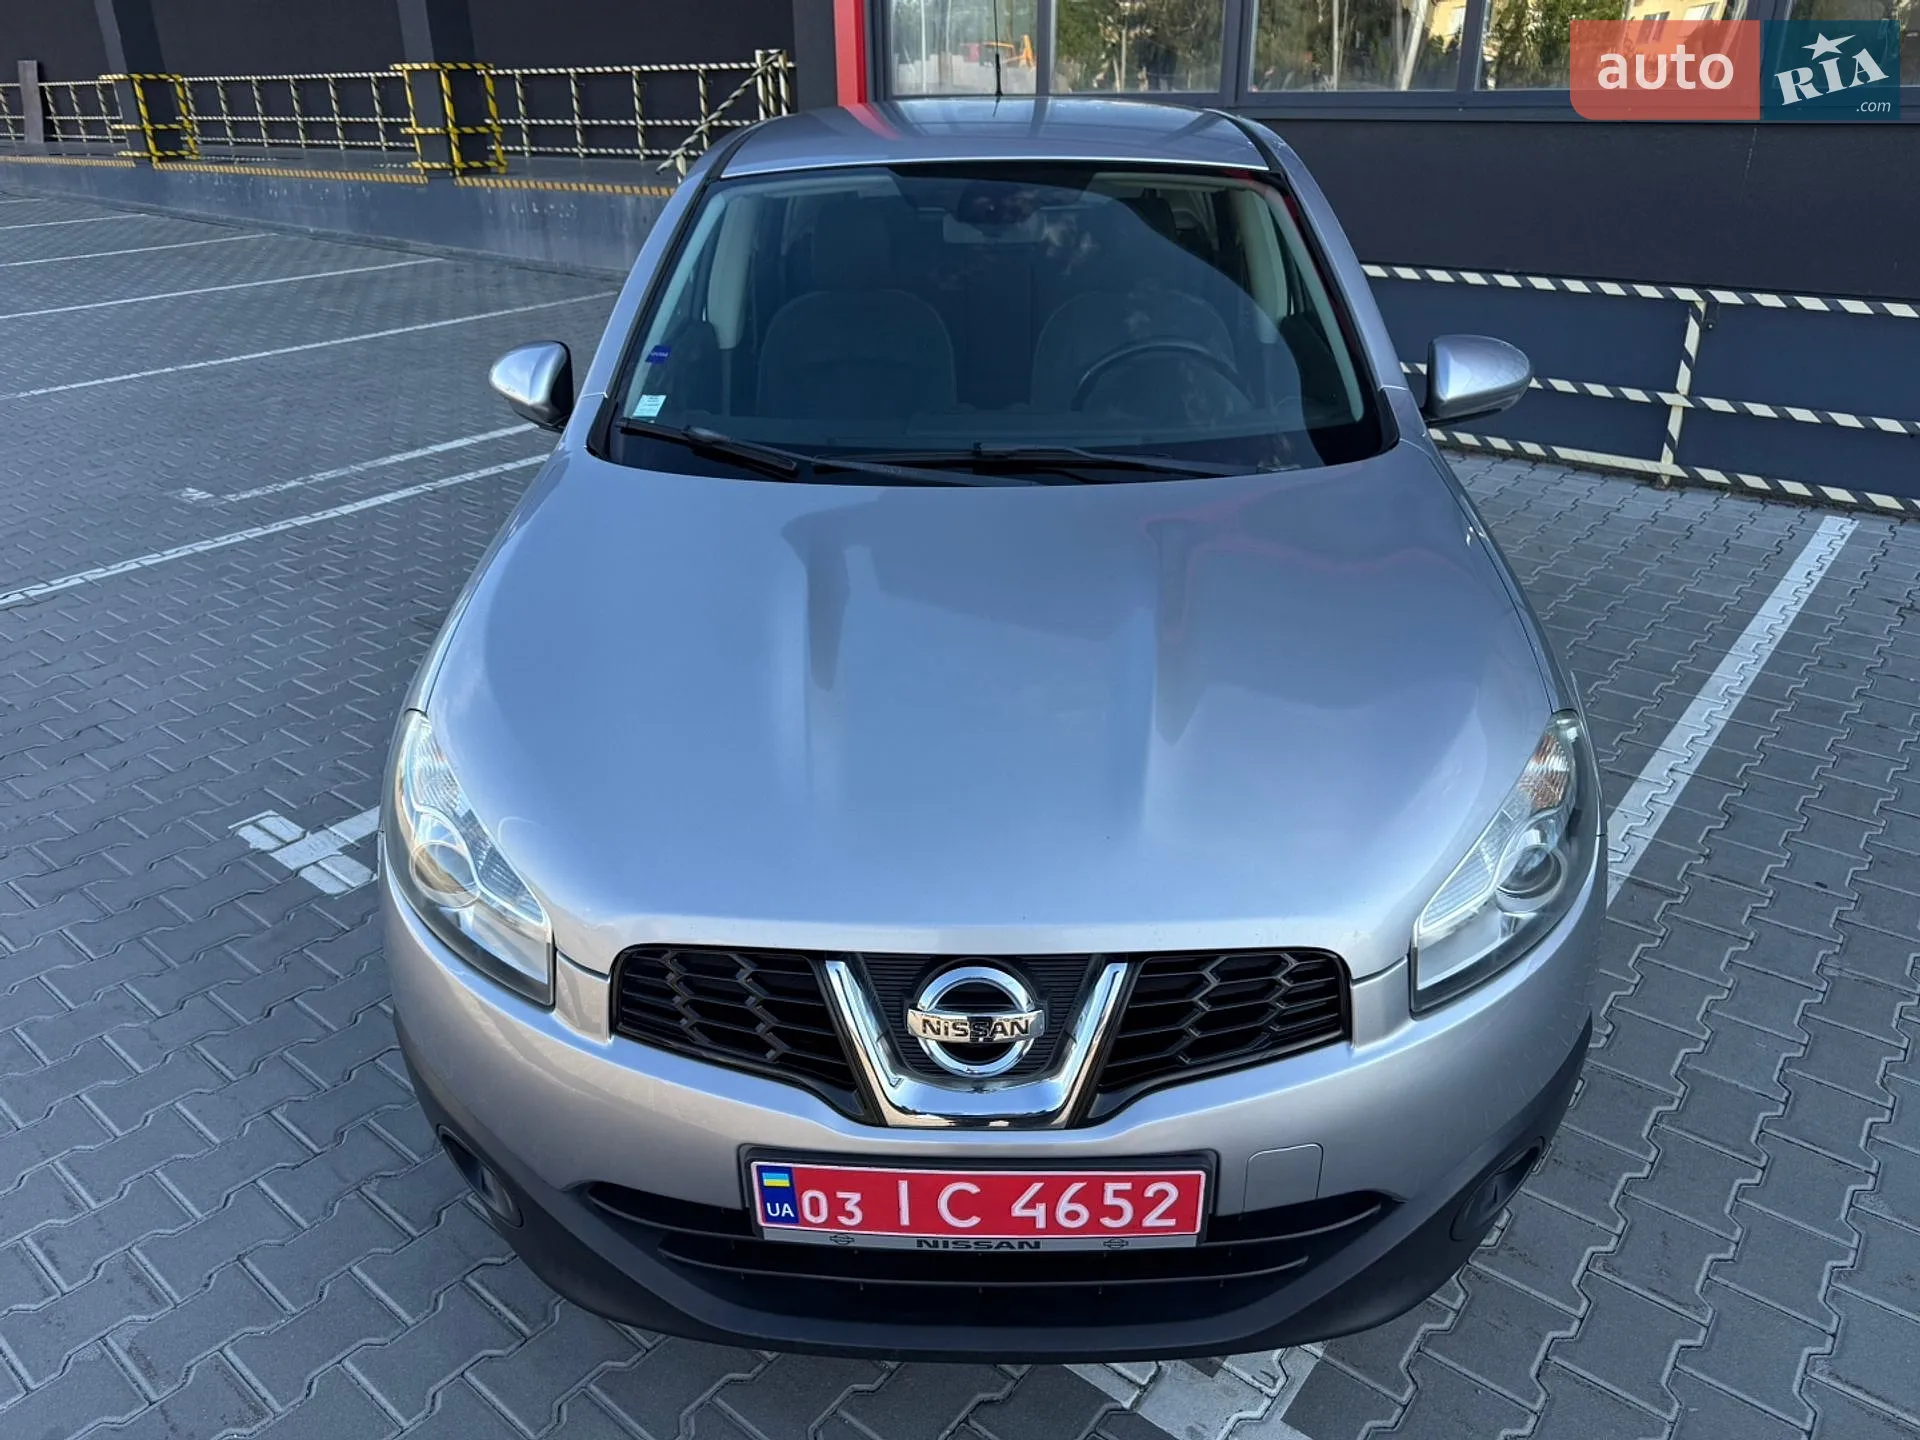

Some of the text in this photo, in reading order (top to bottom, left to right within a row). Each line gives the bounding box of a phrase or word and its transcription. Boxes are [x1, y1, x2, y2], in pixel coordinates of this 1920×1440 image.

[921, 1018, 1029, 1038] NISSAN
[766, 1202, 795, 1218] UA
[801, 1189, 864, 1226] 03
[1011, 1181, 1180, 1229] 4652
[915, 1239, 1041, 1251] NISSAN
